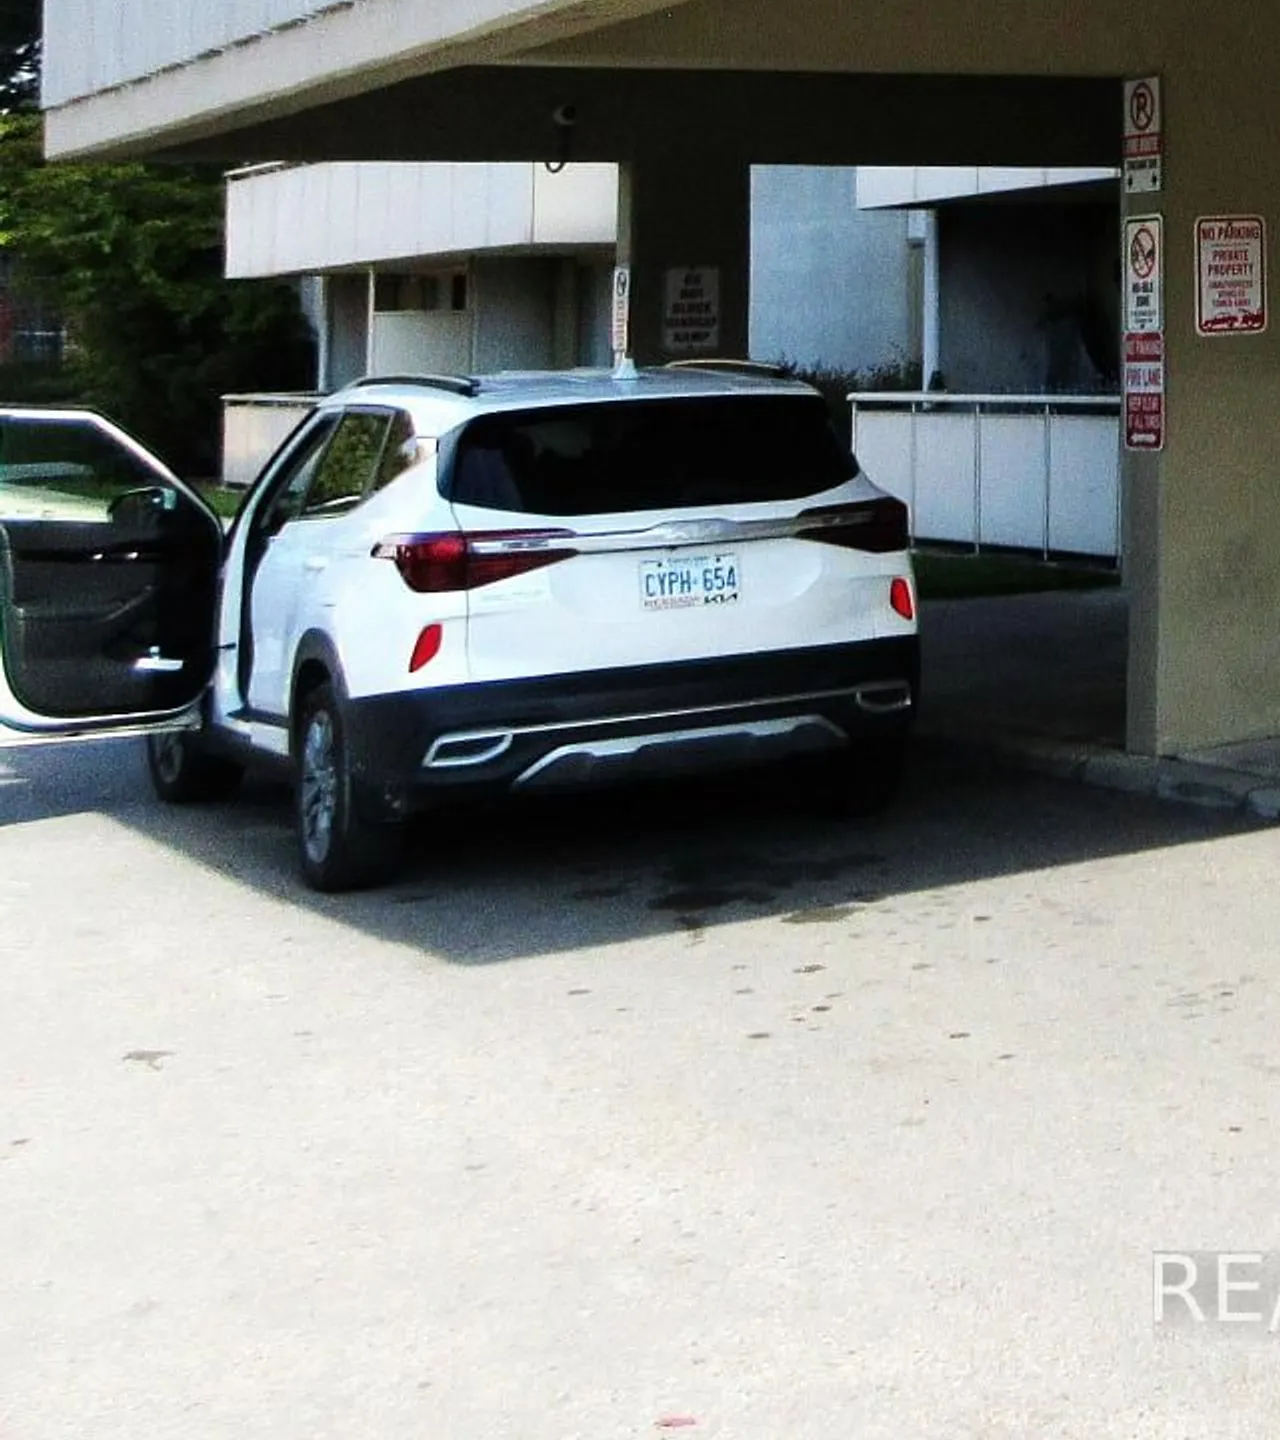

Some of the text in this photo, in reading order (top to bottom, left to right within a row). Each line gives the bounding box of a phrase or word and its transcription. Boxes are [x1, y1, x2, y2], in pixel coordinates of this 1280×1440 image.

[1202, 226, 1259, 240] NO PARKING
[1208, 263, 1253, 276] PROPERTY
[645, 566, 736, 597] CYPH 654
